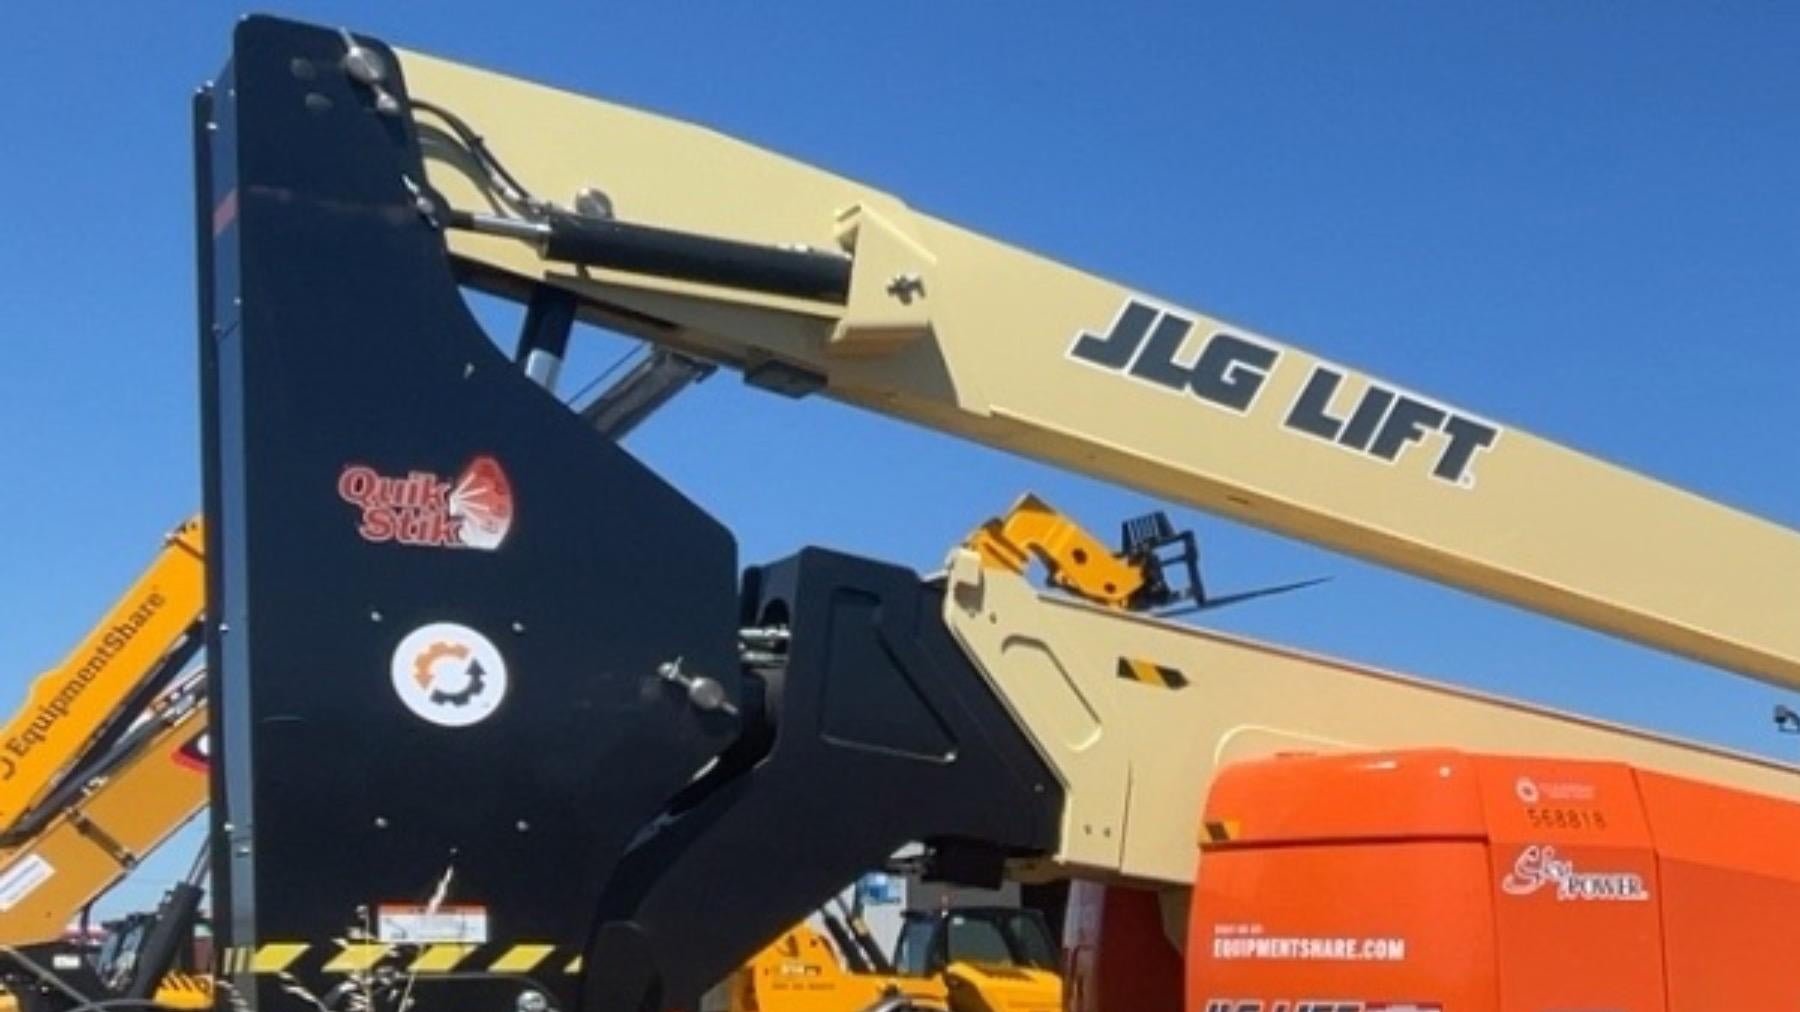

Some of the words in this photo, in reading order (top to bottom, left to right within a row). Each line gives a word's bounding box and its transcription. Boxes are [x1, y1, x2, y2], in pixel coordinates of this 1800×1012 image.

[1067, 297, 1283, 416] JLG
[1280, 363, 1502, 488] LIFT
[339, 467, 450, 512] Quik
[360, 506, 465, 548] Stik
[5, 588, 167, 757] EquipmentShare
[1214, 938, 1405, 960] EQUIPMENTSHARE.COM
